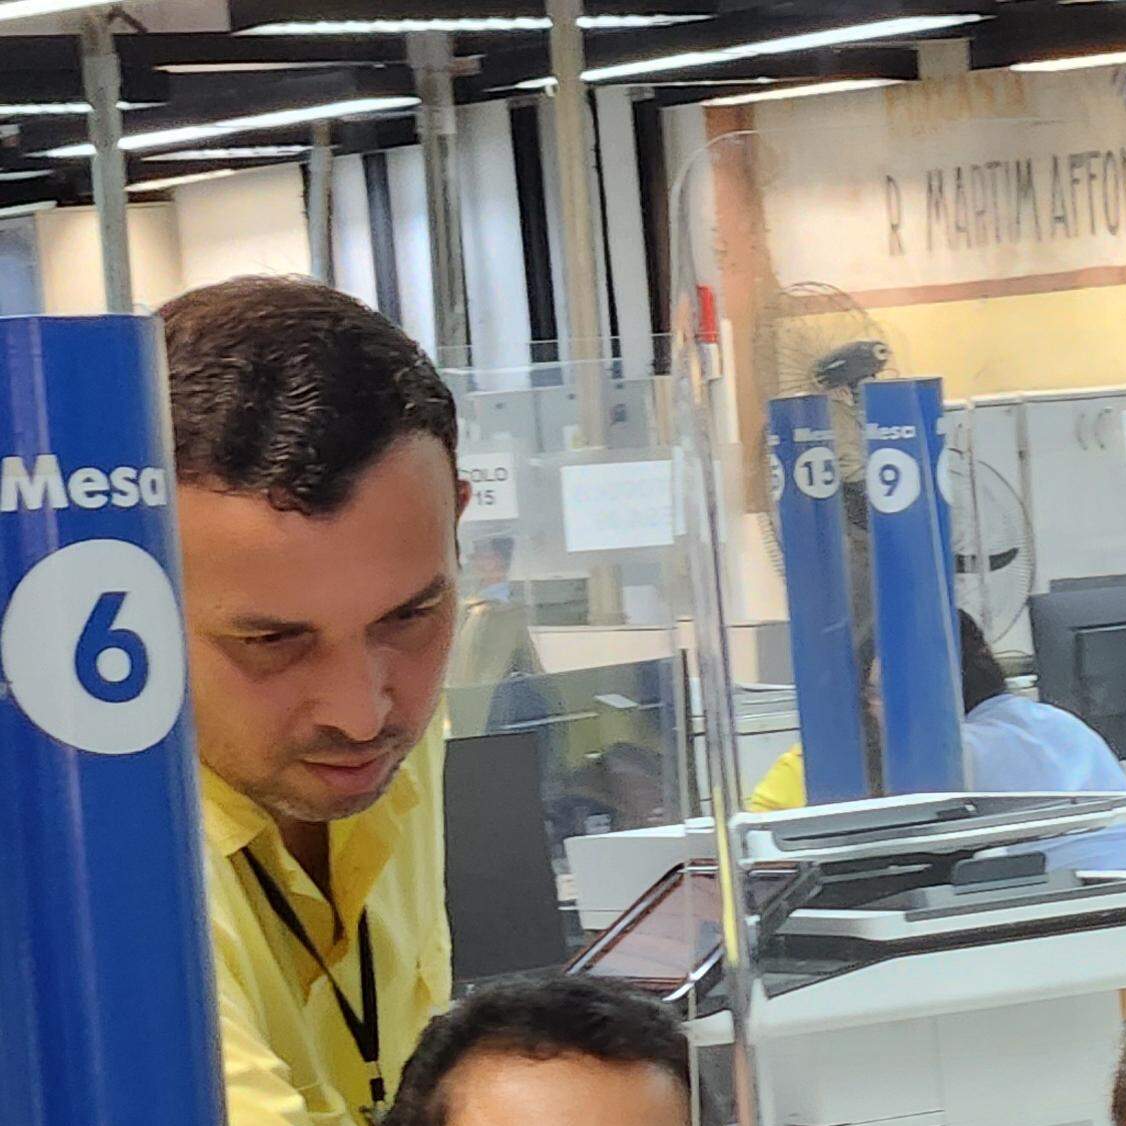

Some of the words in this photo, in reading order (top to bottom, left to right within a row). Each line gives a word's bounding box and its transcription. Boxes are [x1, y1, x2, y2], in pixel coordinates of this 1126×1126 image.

[926, 158, 1042, 251] MARTIM
[0, 454, 168, 512] Mesa
[802, 459, 835, 487] 15
[879, 463, 900, 497] 9
[74, 591, 149, 704] 6
